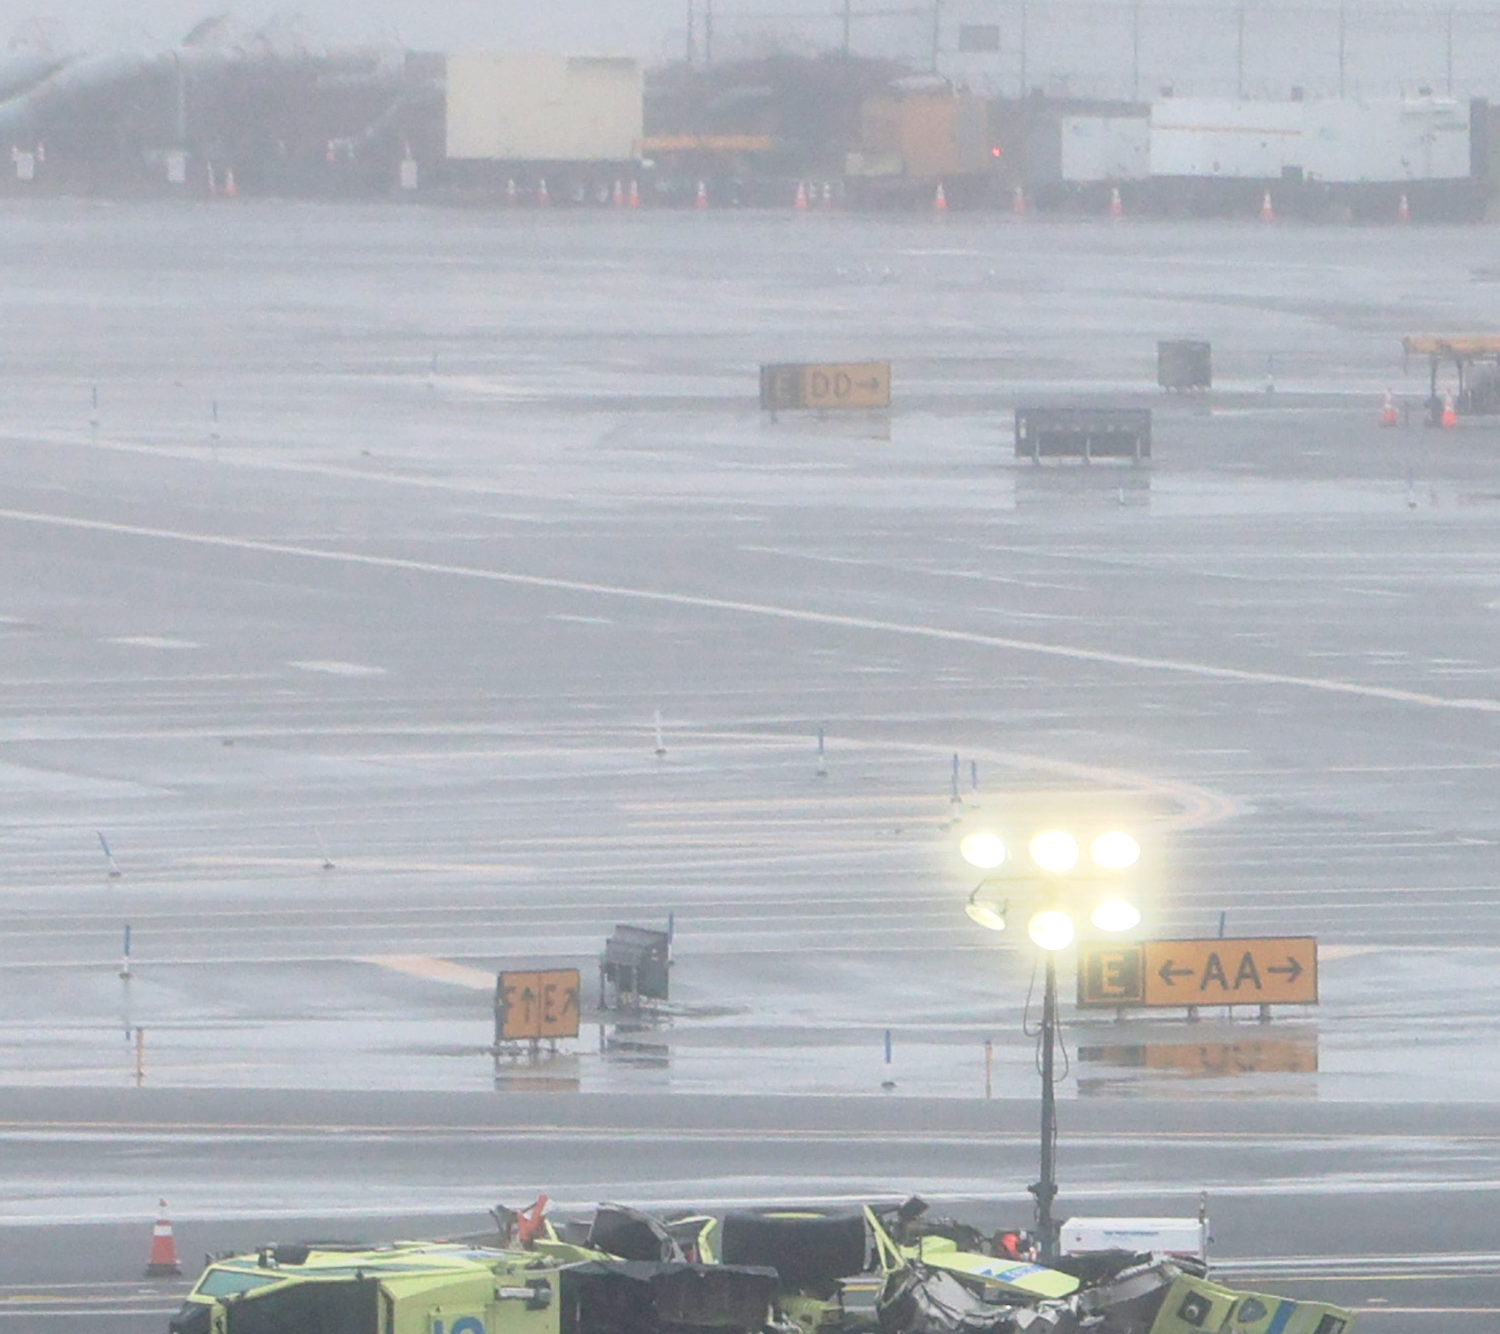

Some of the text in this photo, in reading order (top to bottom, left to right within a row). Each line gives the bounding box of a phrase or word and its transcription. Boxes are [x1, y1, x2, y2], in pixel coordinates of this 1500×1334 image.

[811, 371, 851, 398] DD
[1103, 951, 1262, 995] E AA
